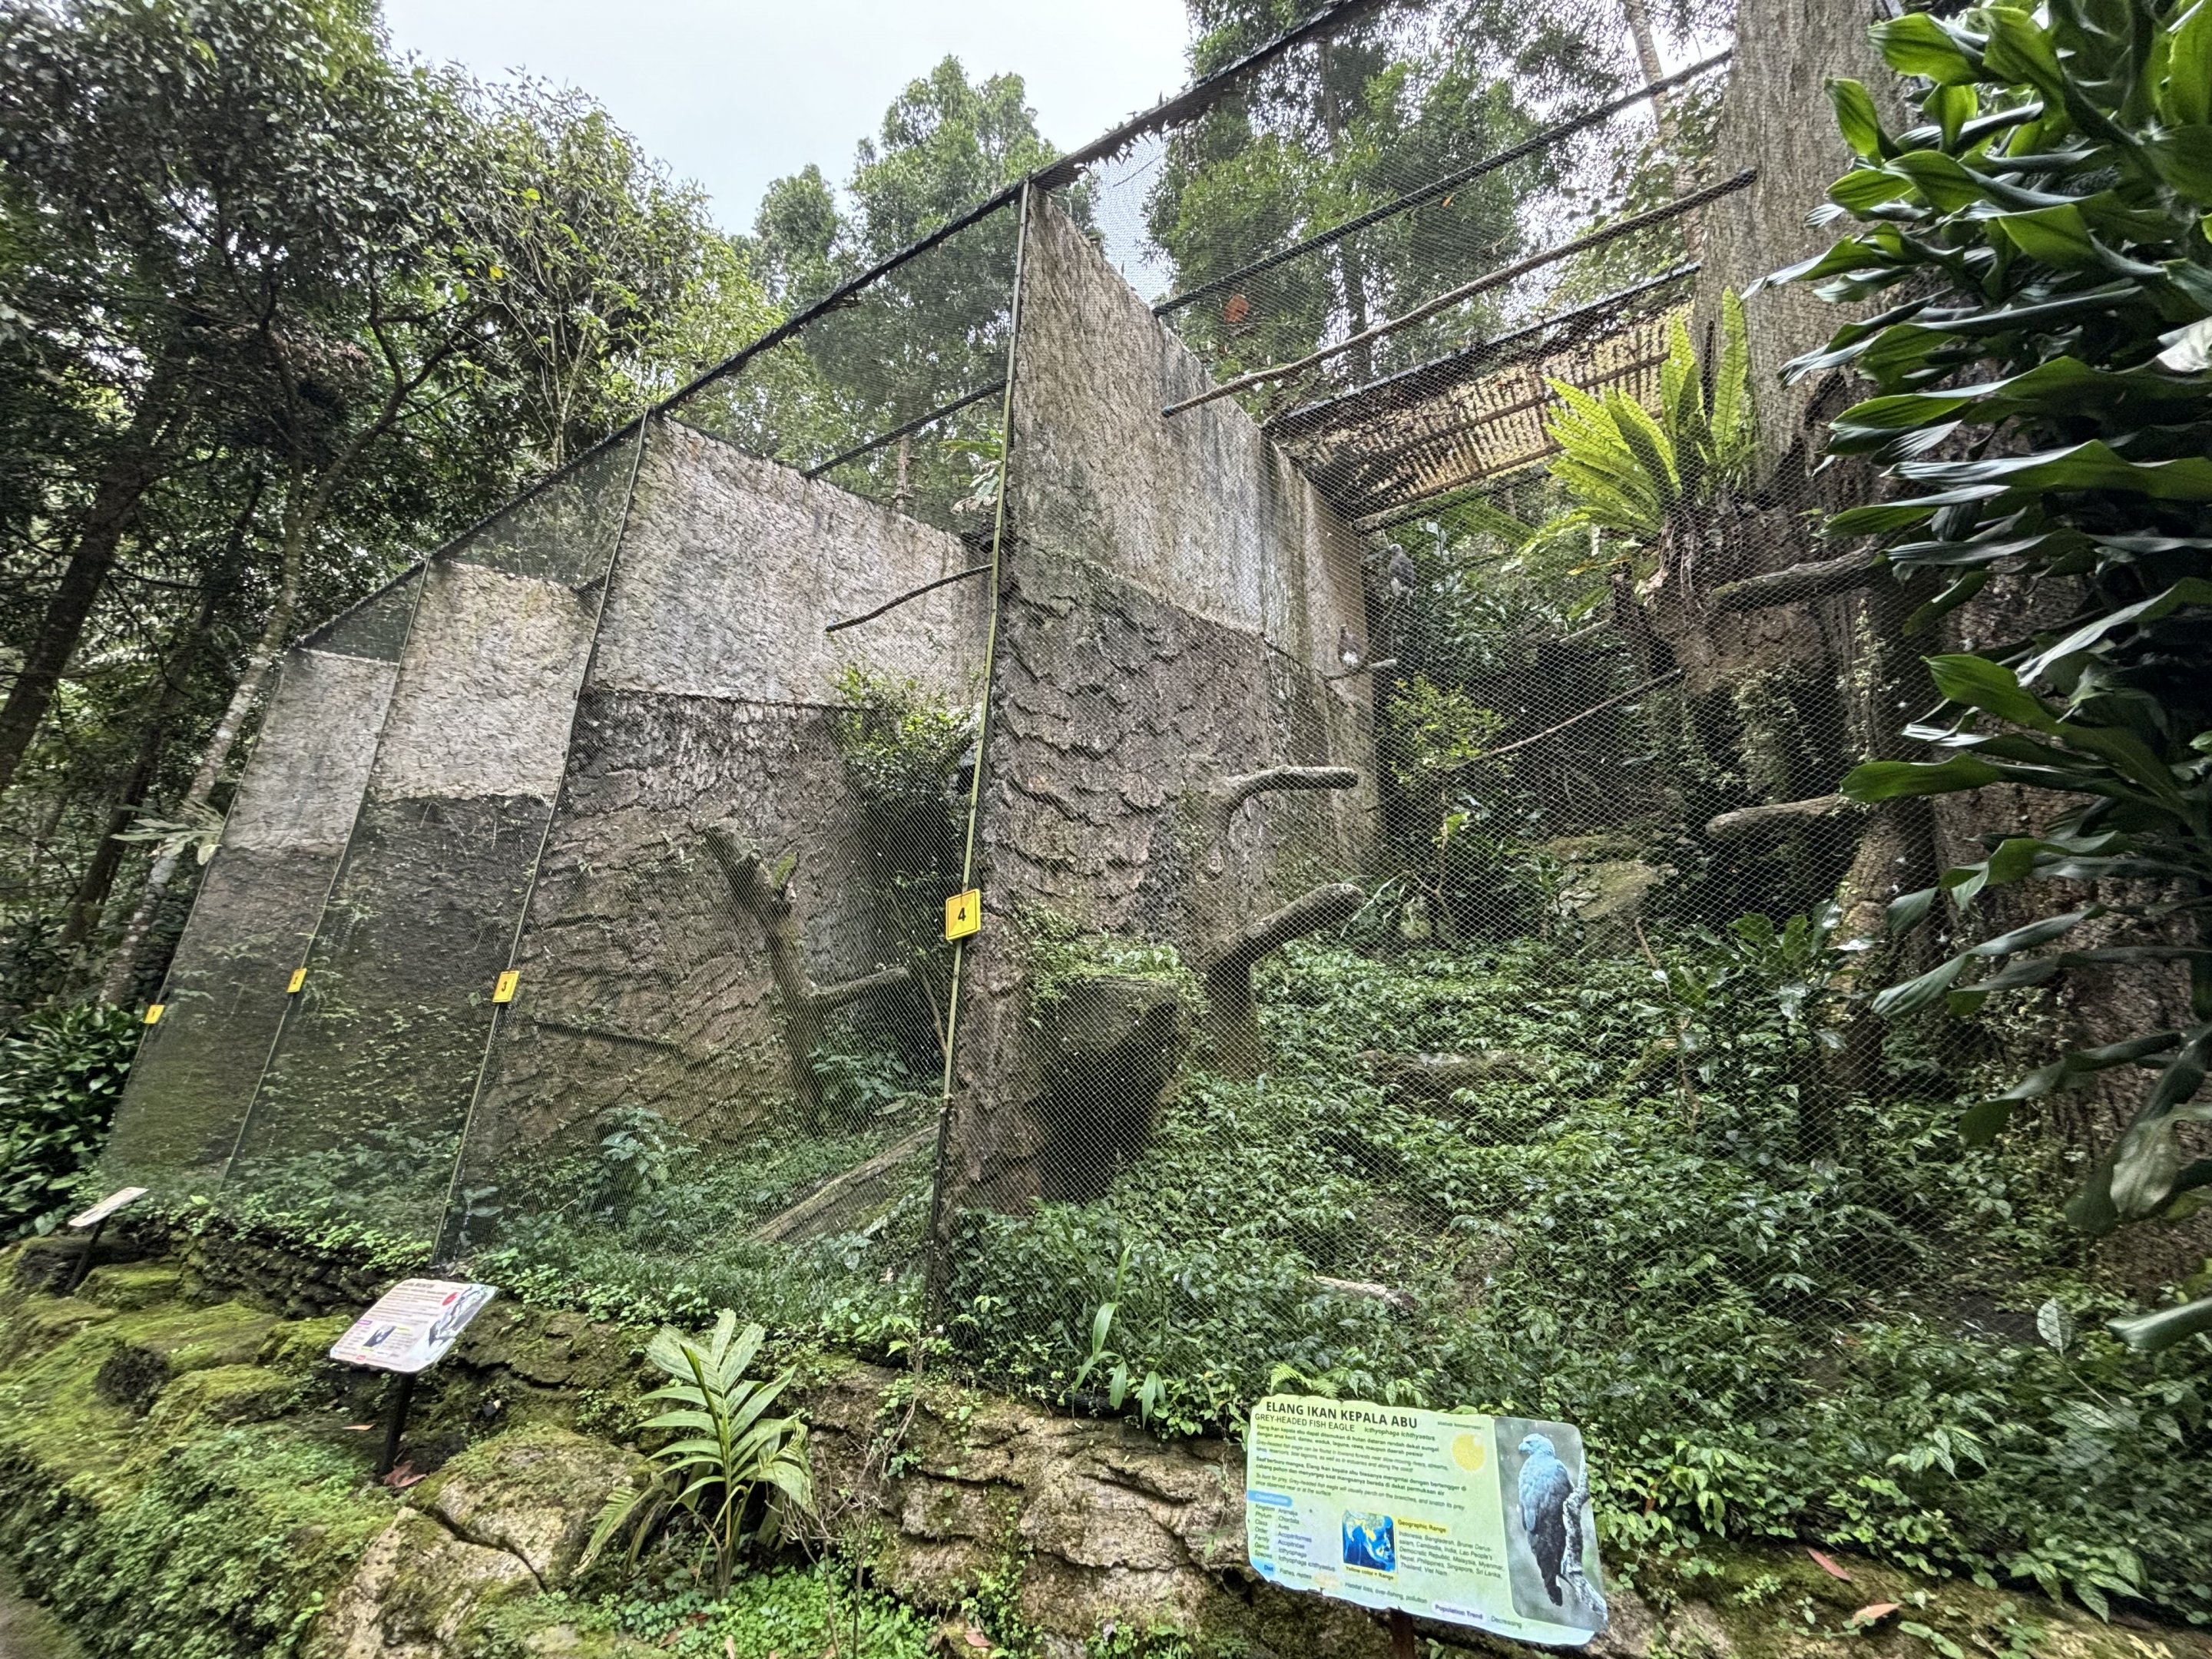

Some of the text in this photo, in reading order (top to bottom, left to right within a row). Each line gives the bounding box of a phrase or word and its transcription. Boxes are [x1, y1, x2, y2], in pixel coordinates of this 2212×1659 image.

[958, 907, 966, 922] 4
[502, 981, 508, 992] 3
[1255, 1413, 1355, 1432] GREY-HEADED FISH EAGLE
[1267, 1401, 1417, 1429] ELANG IKAN KEPALA ABU
[1306, 1462, 1320, 1471] Elang
[1430, 1481, 1460, 1491] bertengger
[1398, 1518, 1446, 1534] Geographic Range
[1435, 1604, 1483, 1620] Population Trend
